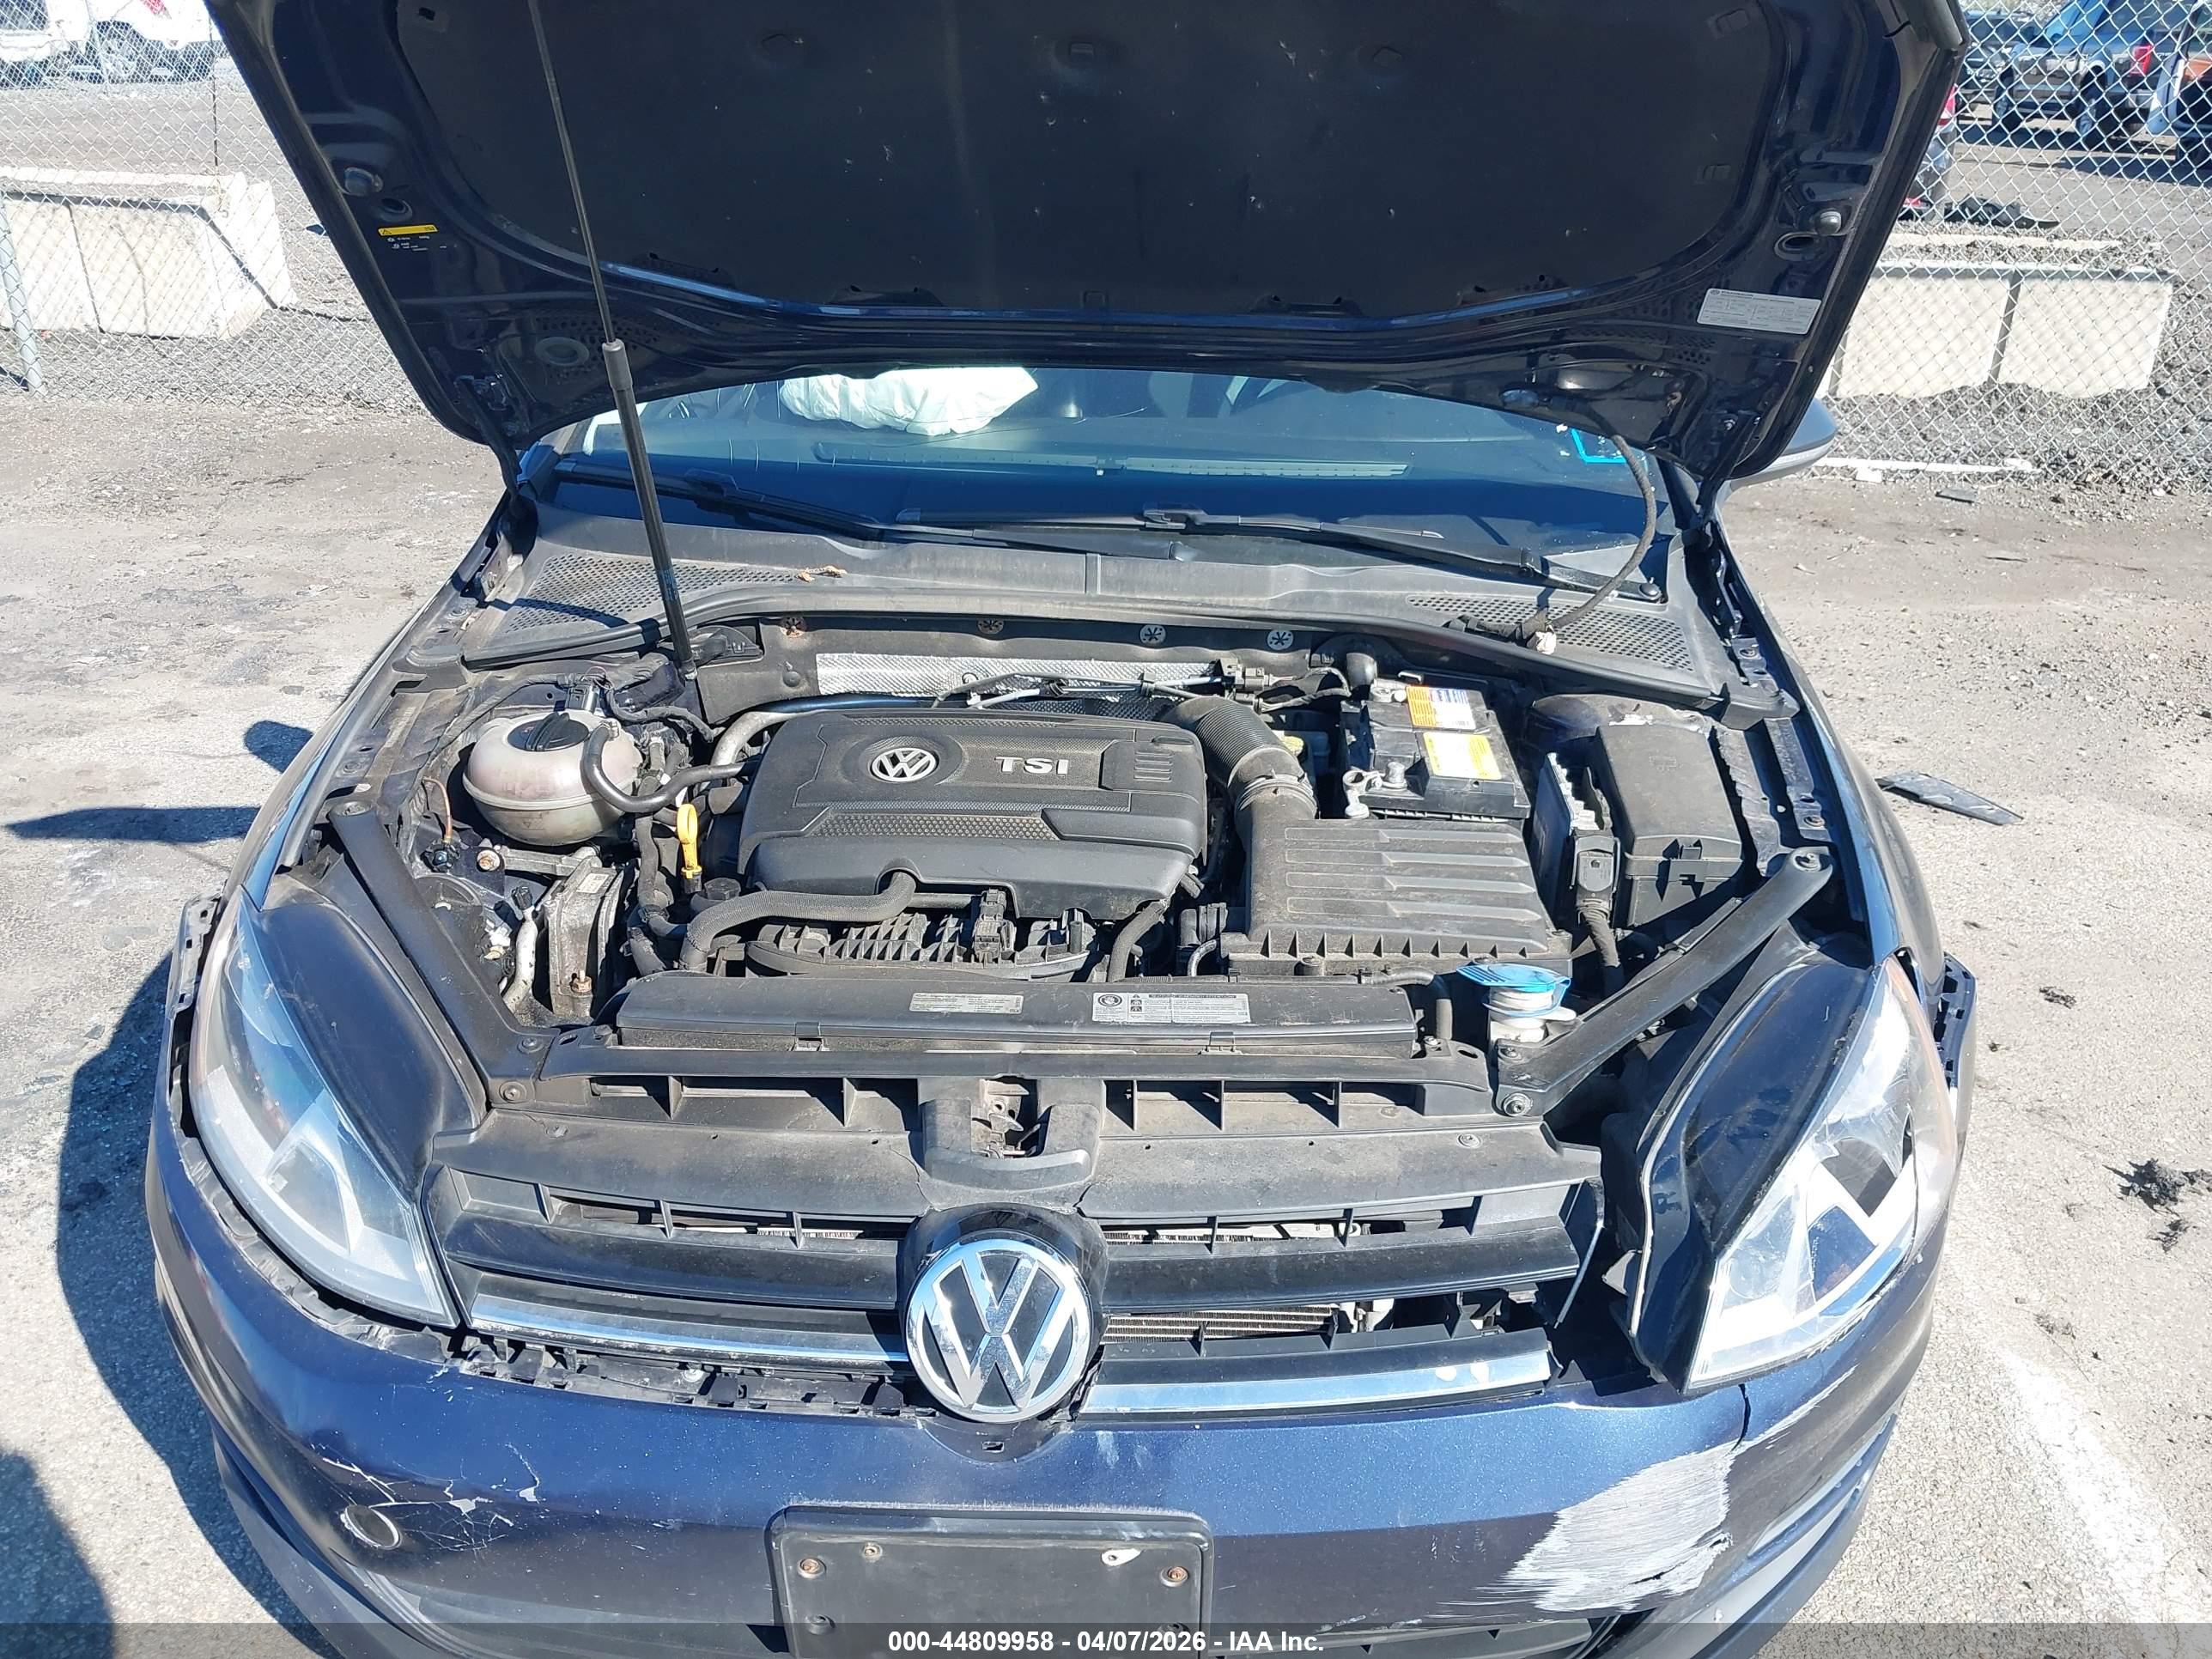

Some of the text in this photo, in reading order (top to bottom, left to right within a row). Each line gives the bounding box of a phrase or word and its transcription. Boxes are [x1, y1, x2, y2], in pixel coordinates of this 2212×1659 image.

[871, 747, 935, 781] VW
[994, 756, 1069, 775] TSI
[906, 1238, 1091, 1423] VW
